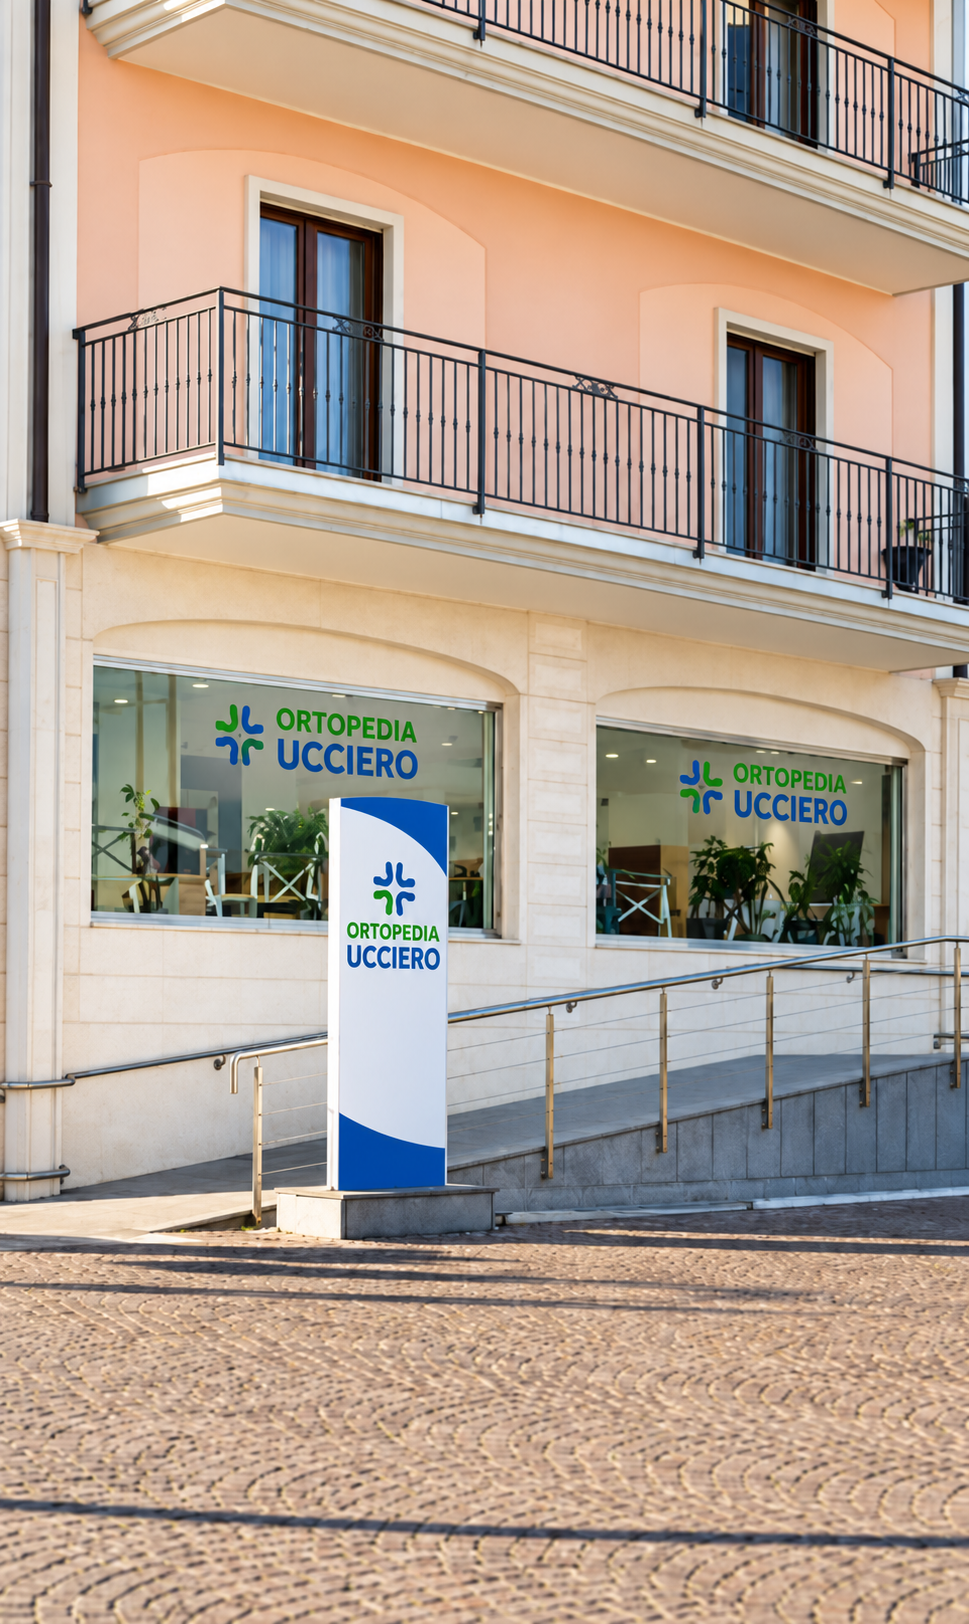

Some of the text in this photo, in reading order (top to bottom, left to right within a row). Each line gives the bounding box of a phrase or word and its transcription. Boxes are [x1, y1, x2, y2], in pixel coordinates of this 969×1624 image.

[276, 707, 417, 743] ORTOPEDIA
[277, 738, 419, 780] UCCIERO
[733, 762, 847, 794] ORTOPEDIA
[734, 789, 848, 826] UCCIERO
[346, 921, 440, 942] ORTOPEDIA
[346, 944, 441, 971] UCCIERO
